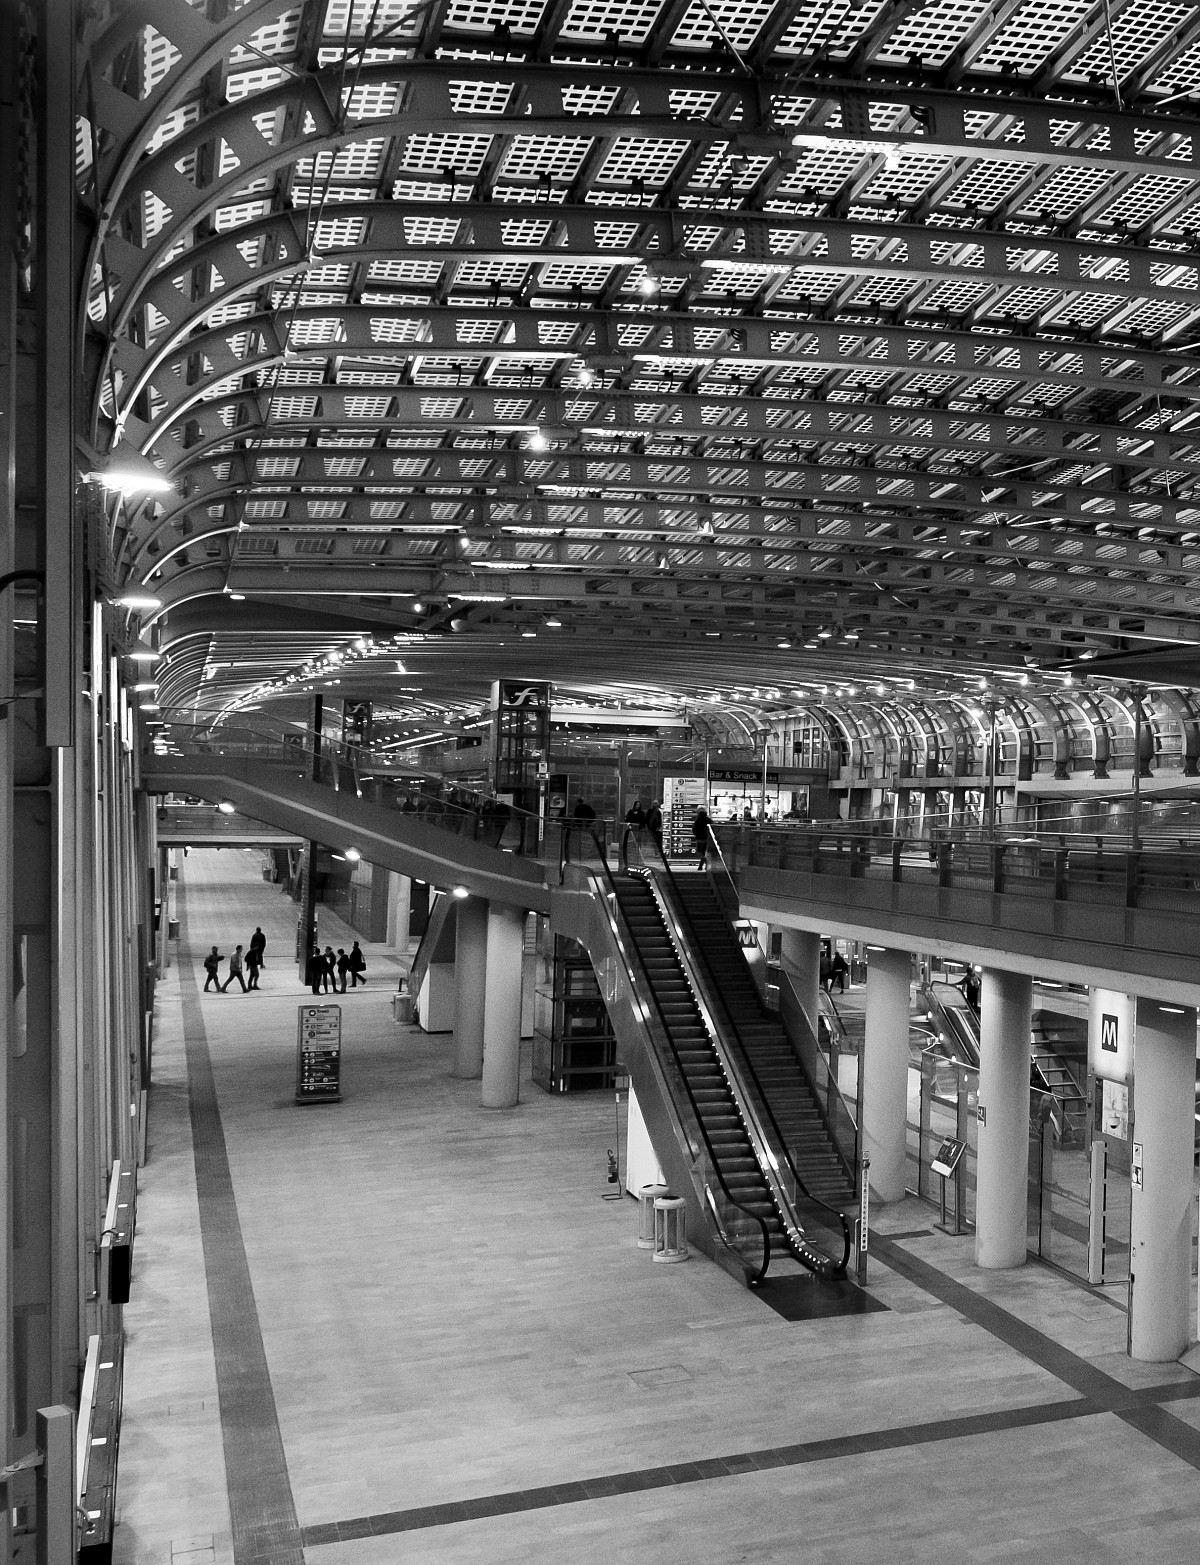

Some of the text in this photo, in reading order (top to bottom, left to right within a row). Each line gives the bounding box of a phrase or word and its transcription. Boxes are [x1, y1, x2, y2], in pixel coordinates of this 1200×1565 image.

[709, 770, 724, 778] Bar
[725, 771, 731, 779] &
[733, 771, 757, 780] Snack
[1102, 1020, 1117, 1047] M
